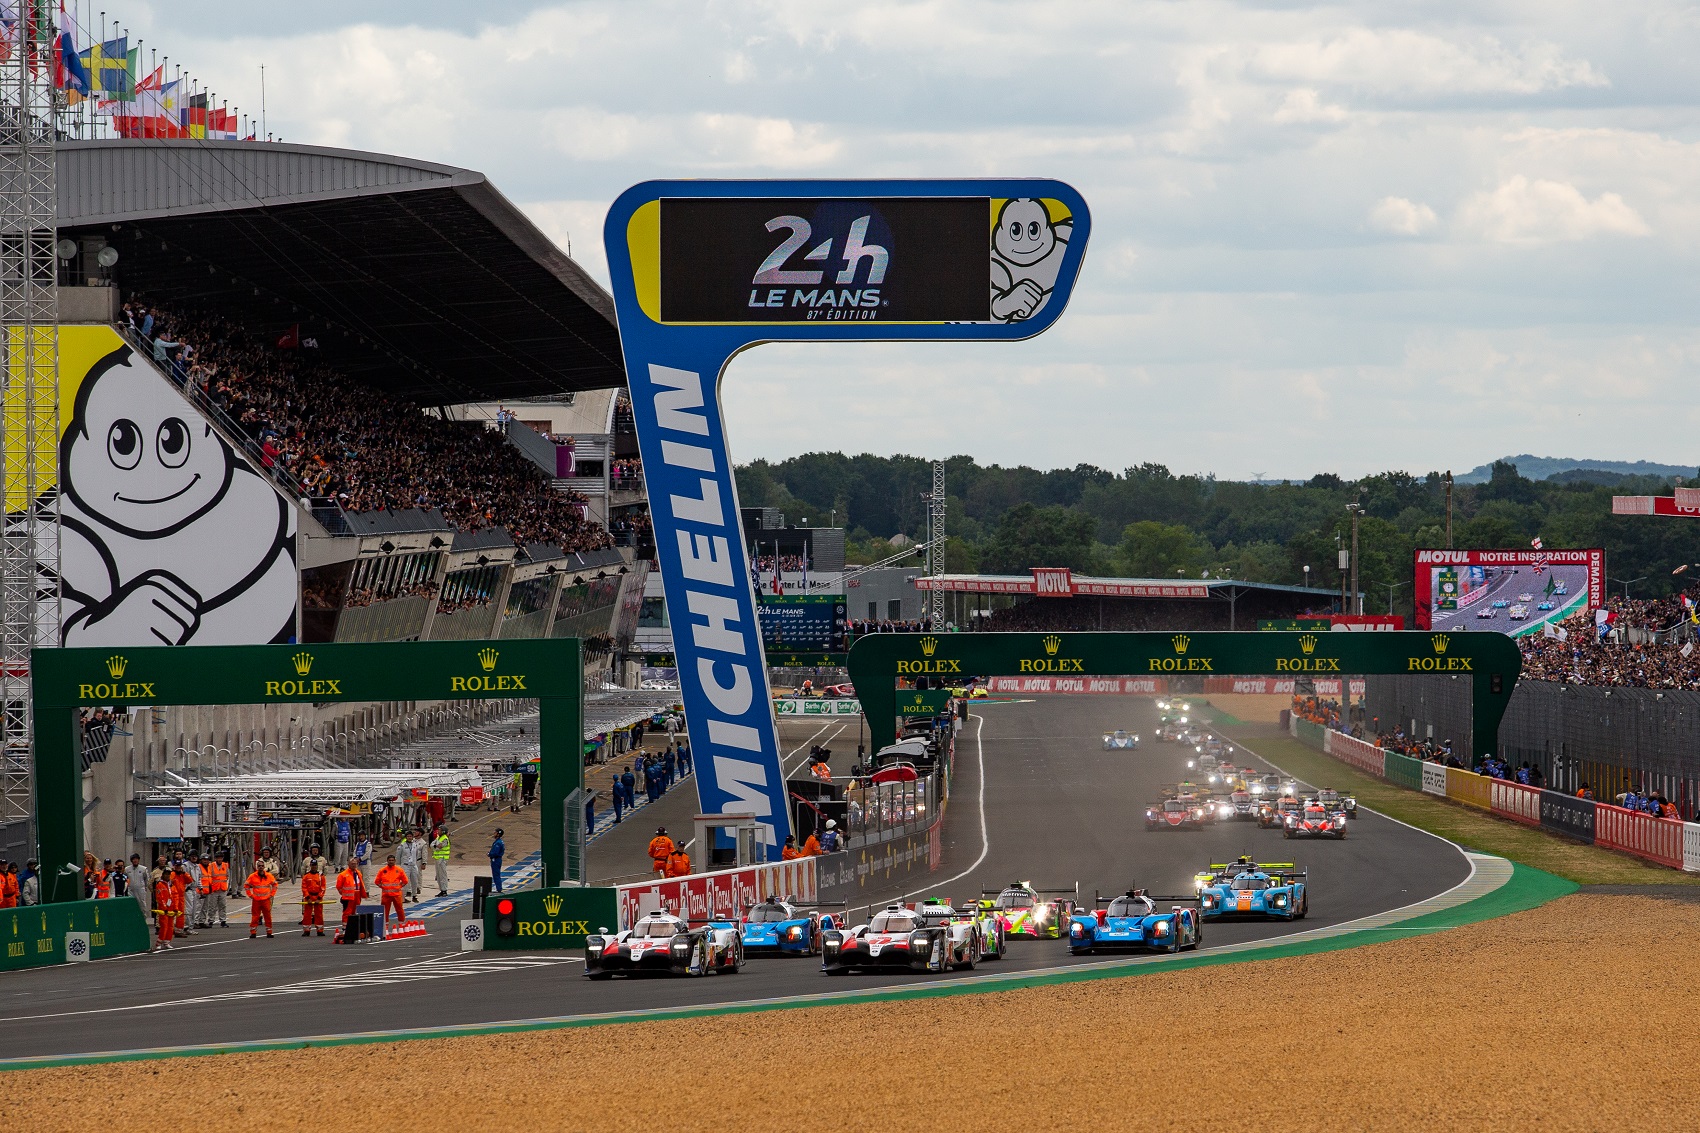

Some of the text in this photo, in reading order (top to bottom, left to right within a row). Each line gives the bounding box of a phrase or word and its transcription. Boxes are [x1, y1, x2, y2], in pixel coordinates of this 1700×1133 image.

[753, 215, 889, 285] 24h
[748, 289, 787, 308] LE
[827, 308, 877, 320] ÉDITION
[1418, 551, 1470, 563] MOTUL
[1479, 552, 1516, 562] NOTRE
[1036, 572, 1070, 593] MOTUL
[1591, 552, 1600, 607] DEMARRE
[648, 363, 777, 847] MICHELIN
[896, 660, 961, 673] ROLEX
[1019, 659, 1084, 672] ROLEX
[1148, 658, 1213, 671] ROLEX
[1276, 658, 1340, 671] ROLEX
[1407, 657, 1473, 671] ROLEX
[265, 679, 342, 696] ROLEX
[451, 674, 528, 692] ROLEX
[998, 680, 1019, 691] MOTUL
[1023, 680, 1050, 691] MOTUL
[1055, 680, 1084, 691] MOTUL
[1089, 680, 1120, 692] MOTUL
[1124, 681, 1156, 693] MOTUL
[1233, 681, 1266, 693] MOTUL
[78, 683, 156, 700] ROLEX
[903, 705, 935, 713] ROLEX
[373, 803, 384, 812] 29
[688, 889, 706, 915] TOTAL
[714, 885, 732, 910] TOTAL
[517, 920, 591, 936] ROLEX
[37, 938, 53, 953] ROLEX
[91, 932, 105, 947] ROLEX
[8, 941, 25, 957] ROLEX
